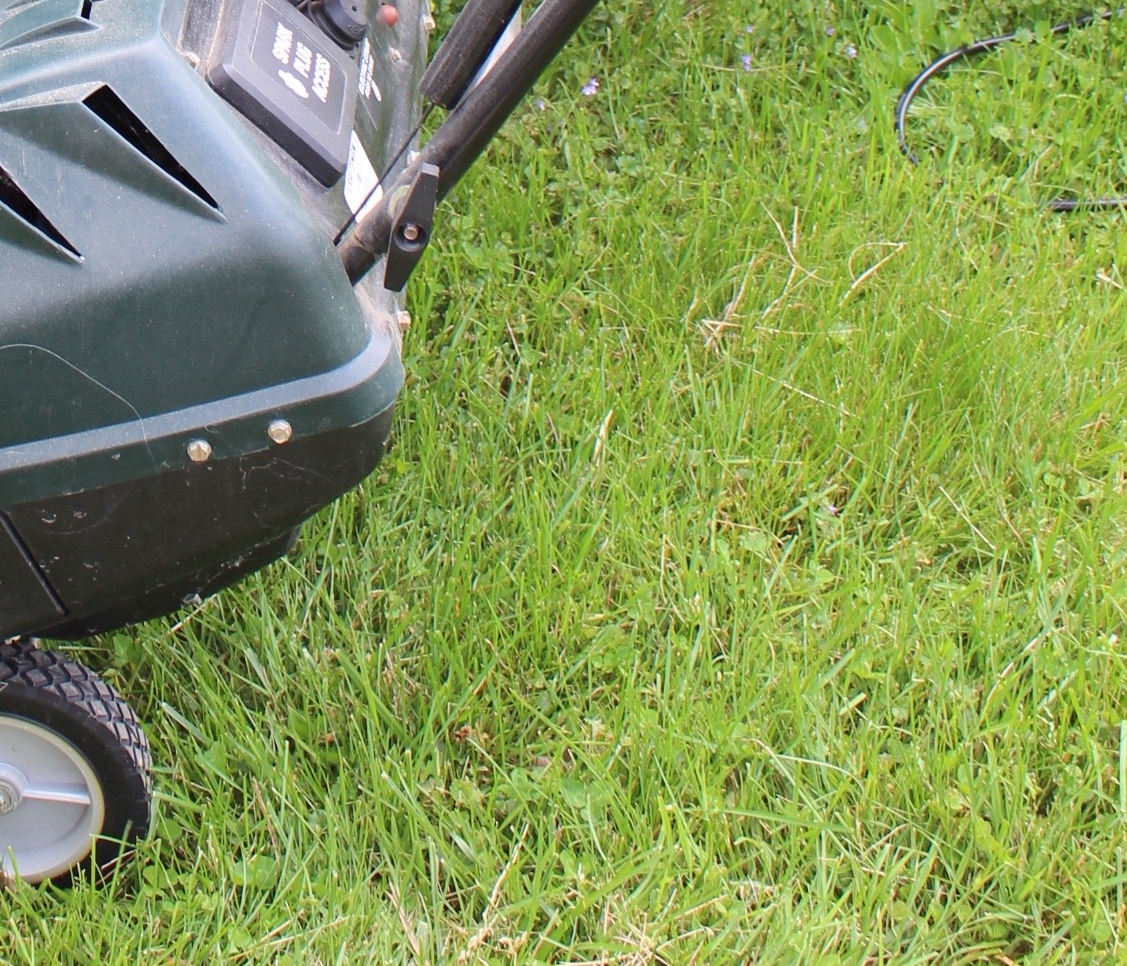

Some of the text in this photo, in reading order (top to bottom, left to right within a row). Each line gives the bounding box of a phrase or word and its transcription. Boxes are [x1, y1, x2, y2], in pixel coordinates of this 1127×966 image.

[272, 21, 293, 64] SPARK
[293, 41, 313, 79] PLUG
[311, 52, 331, 104] ACCESS
